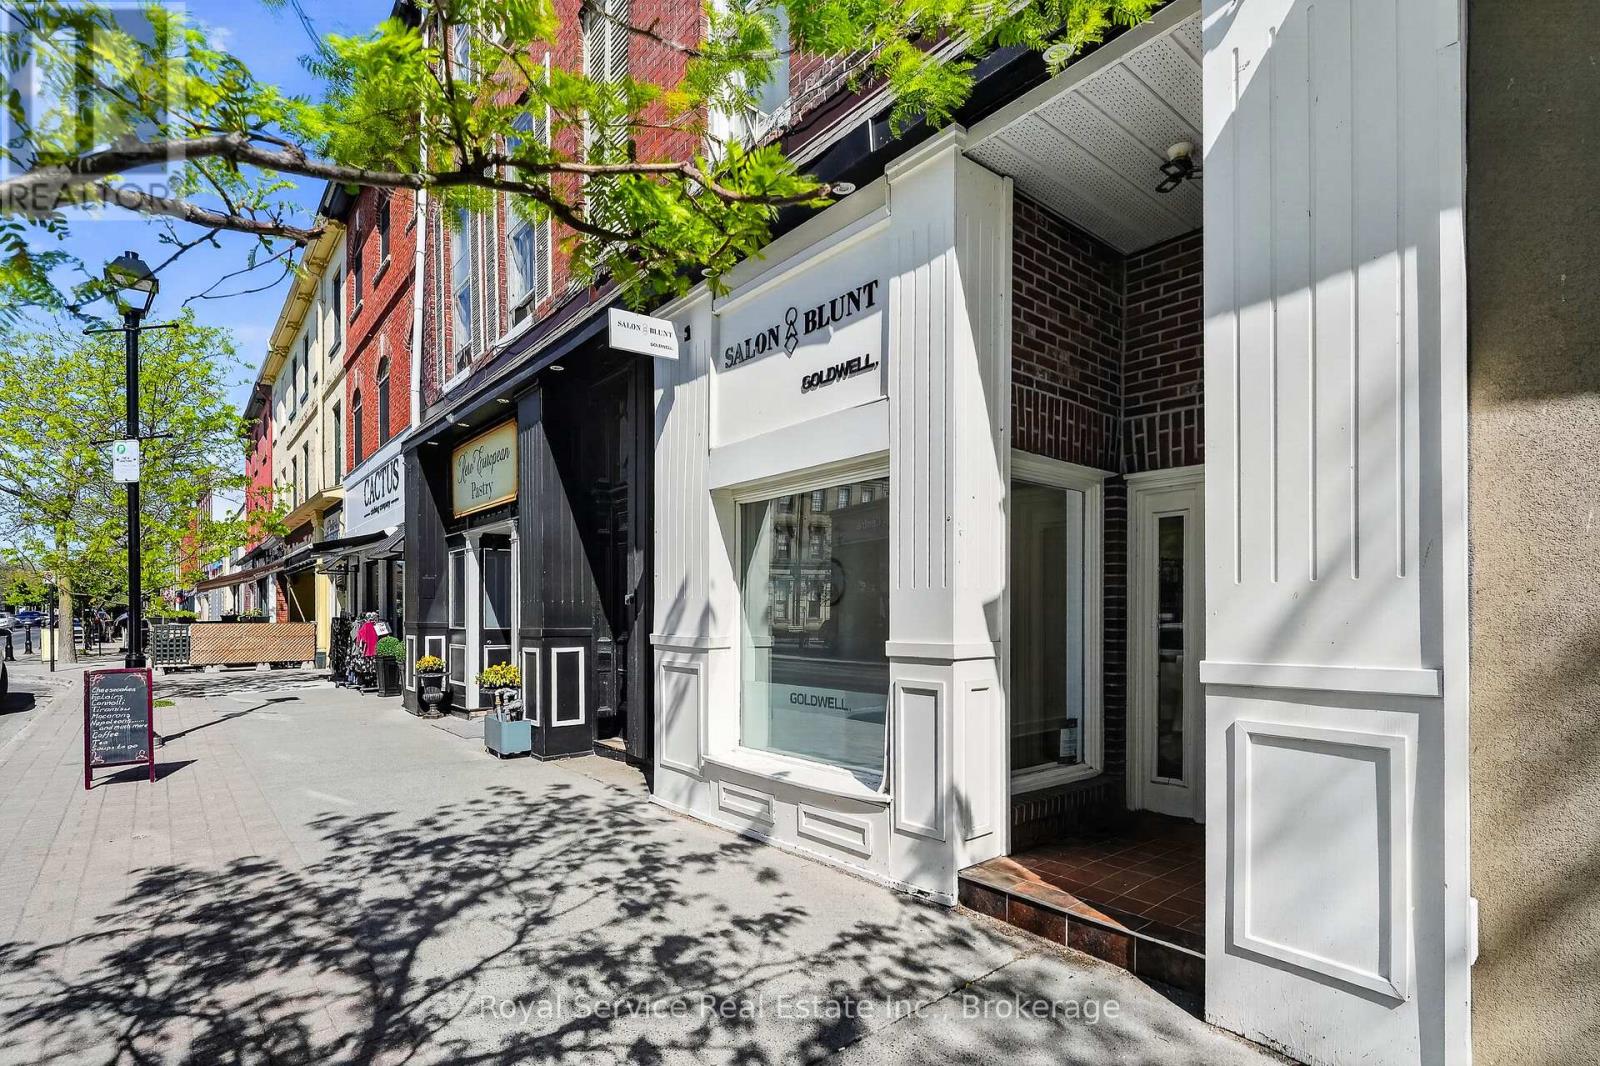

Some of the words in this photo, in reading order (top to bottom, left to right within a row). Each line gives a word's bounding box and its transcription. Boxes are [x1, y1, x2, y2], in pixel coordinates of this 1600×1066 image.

[617, 321, 641, 331] SALON
[649, 327, 673, 338] BLUNT
[725, 325, 781, 369] SALON
[803, 279, 879, 335] BLUNT
[457, 451, 474, 484] New
[473, 445, 511, 478] European
[363, 458, 400, 507] CACTUS
[471, 481, 494, 500] Pastry
[91, 685, 136, 693] Cheesecakes
[92, 730, 119, 739] Coffee
[92, 739, 108, 747] Tea
